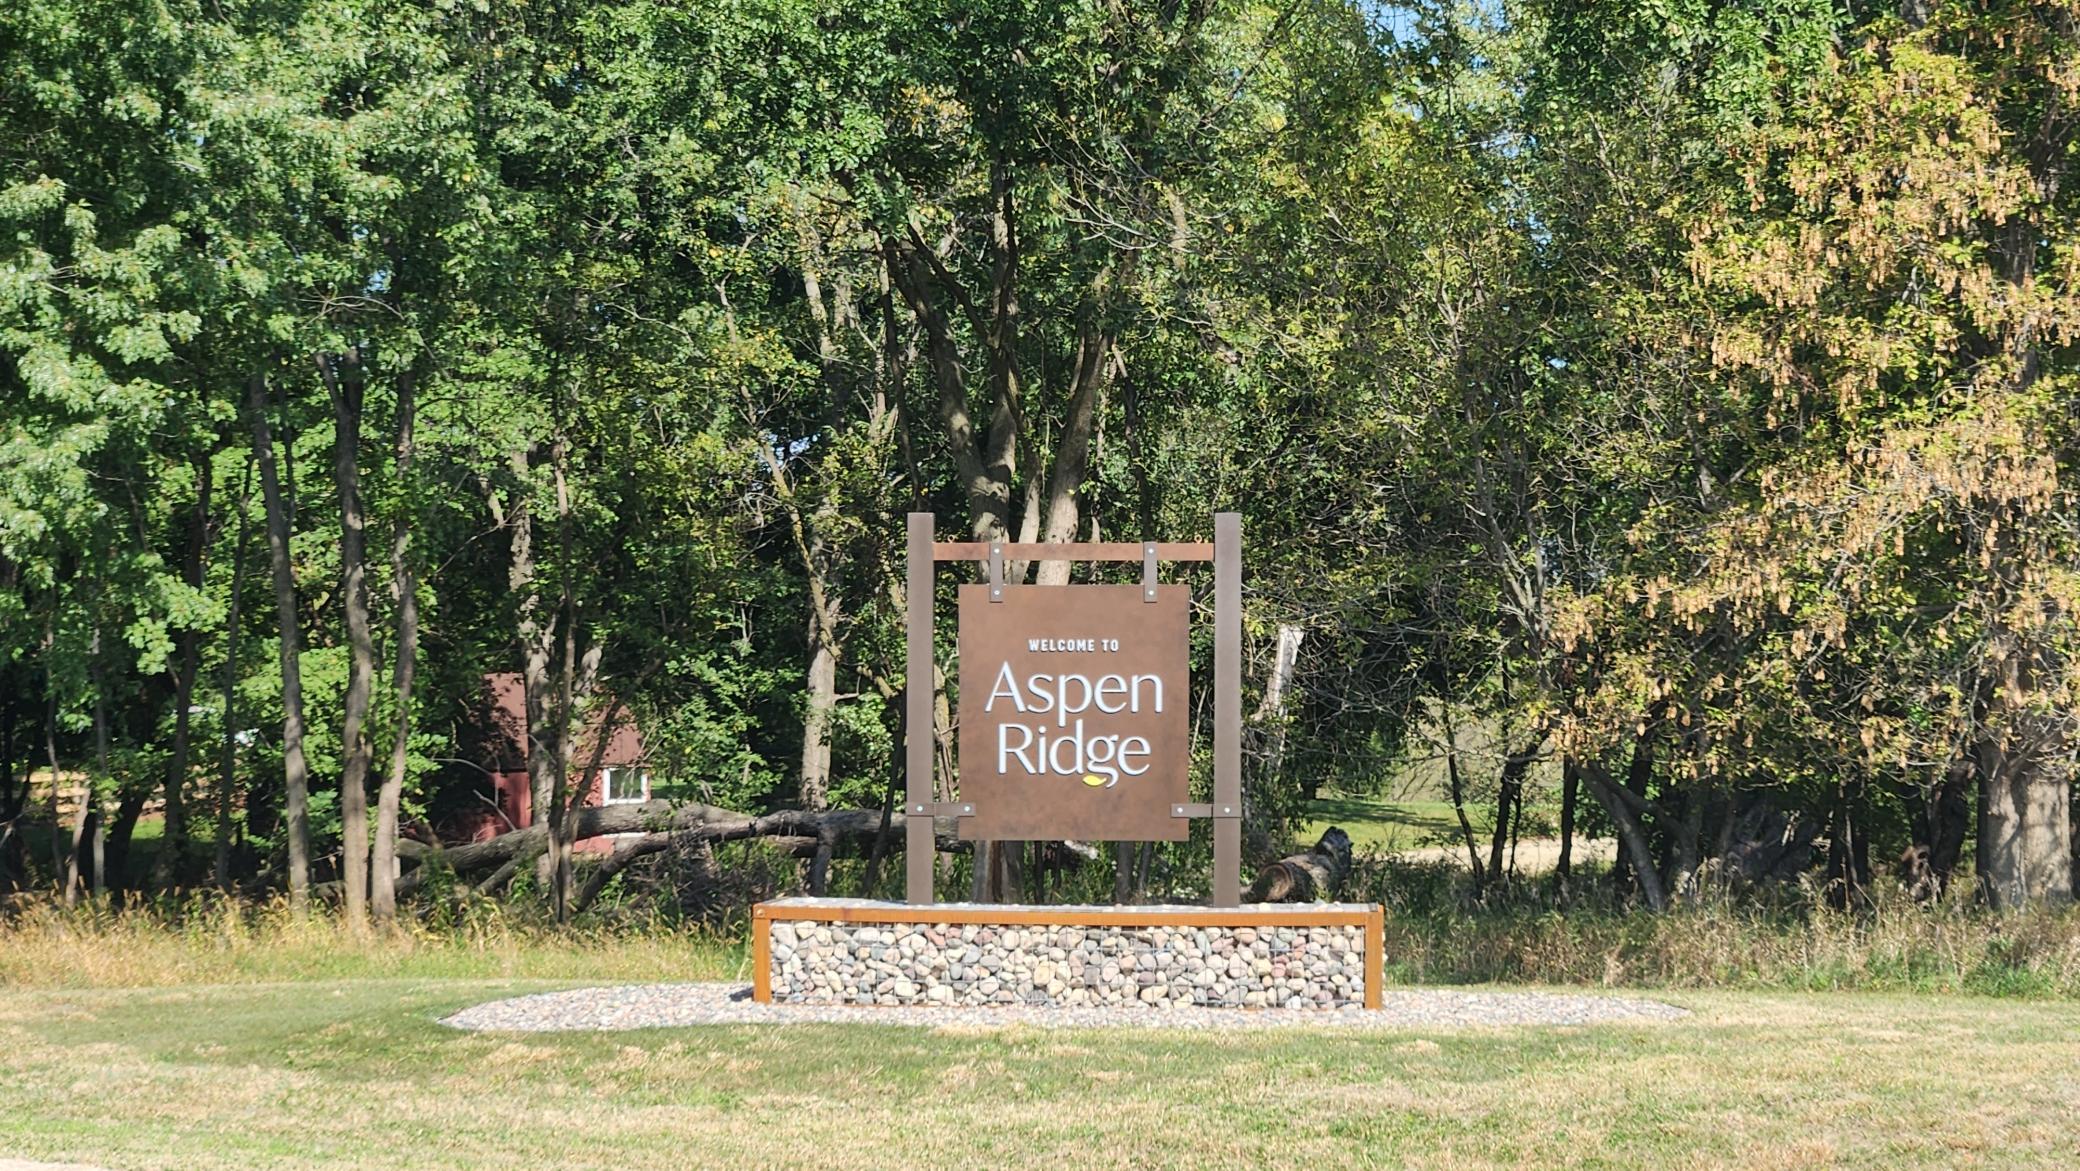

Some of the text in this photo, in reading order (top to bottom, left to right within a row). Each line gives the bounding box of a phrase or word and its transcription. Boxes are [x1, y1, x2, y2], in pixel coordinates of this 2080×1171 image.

[1028, 638, 1120, 653] WELCOME TO
[984, 660, 1164, 728] Aspen
[997, 718, 1152, 788] Ridge
